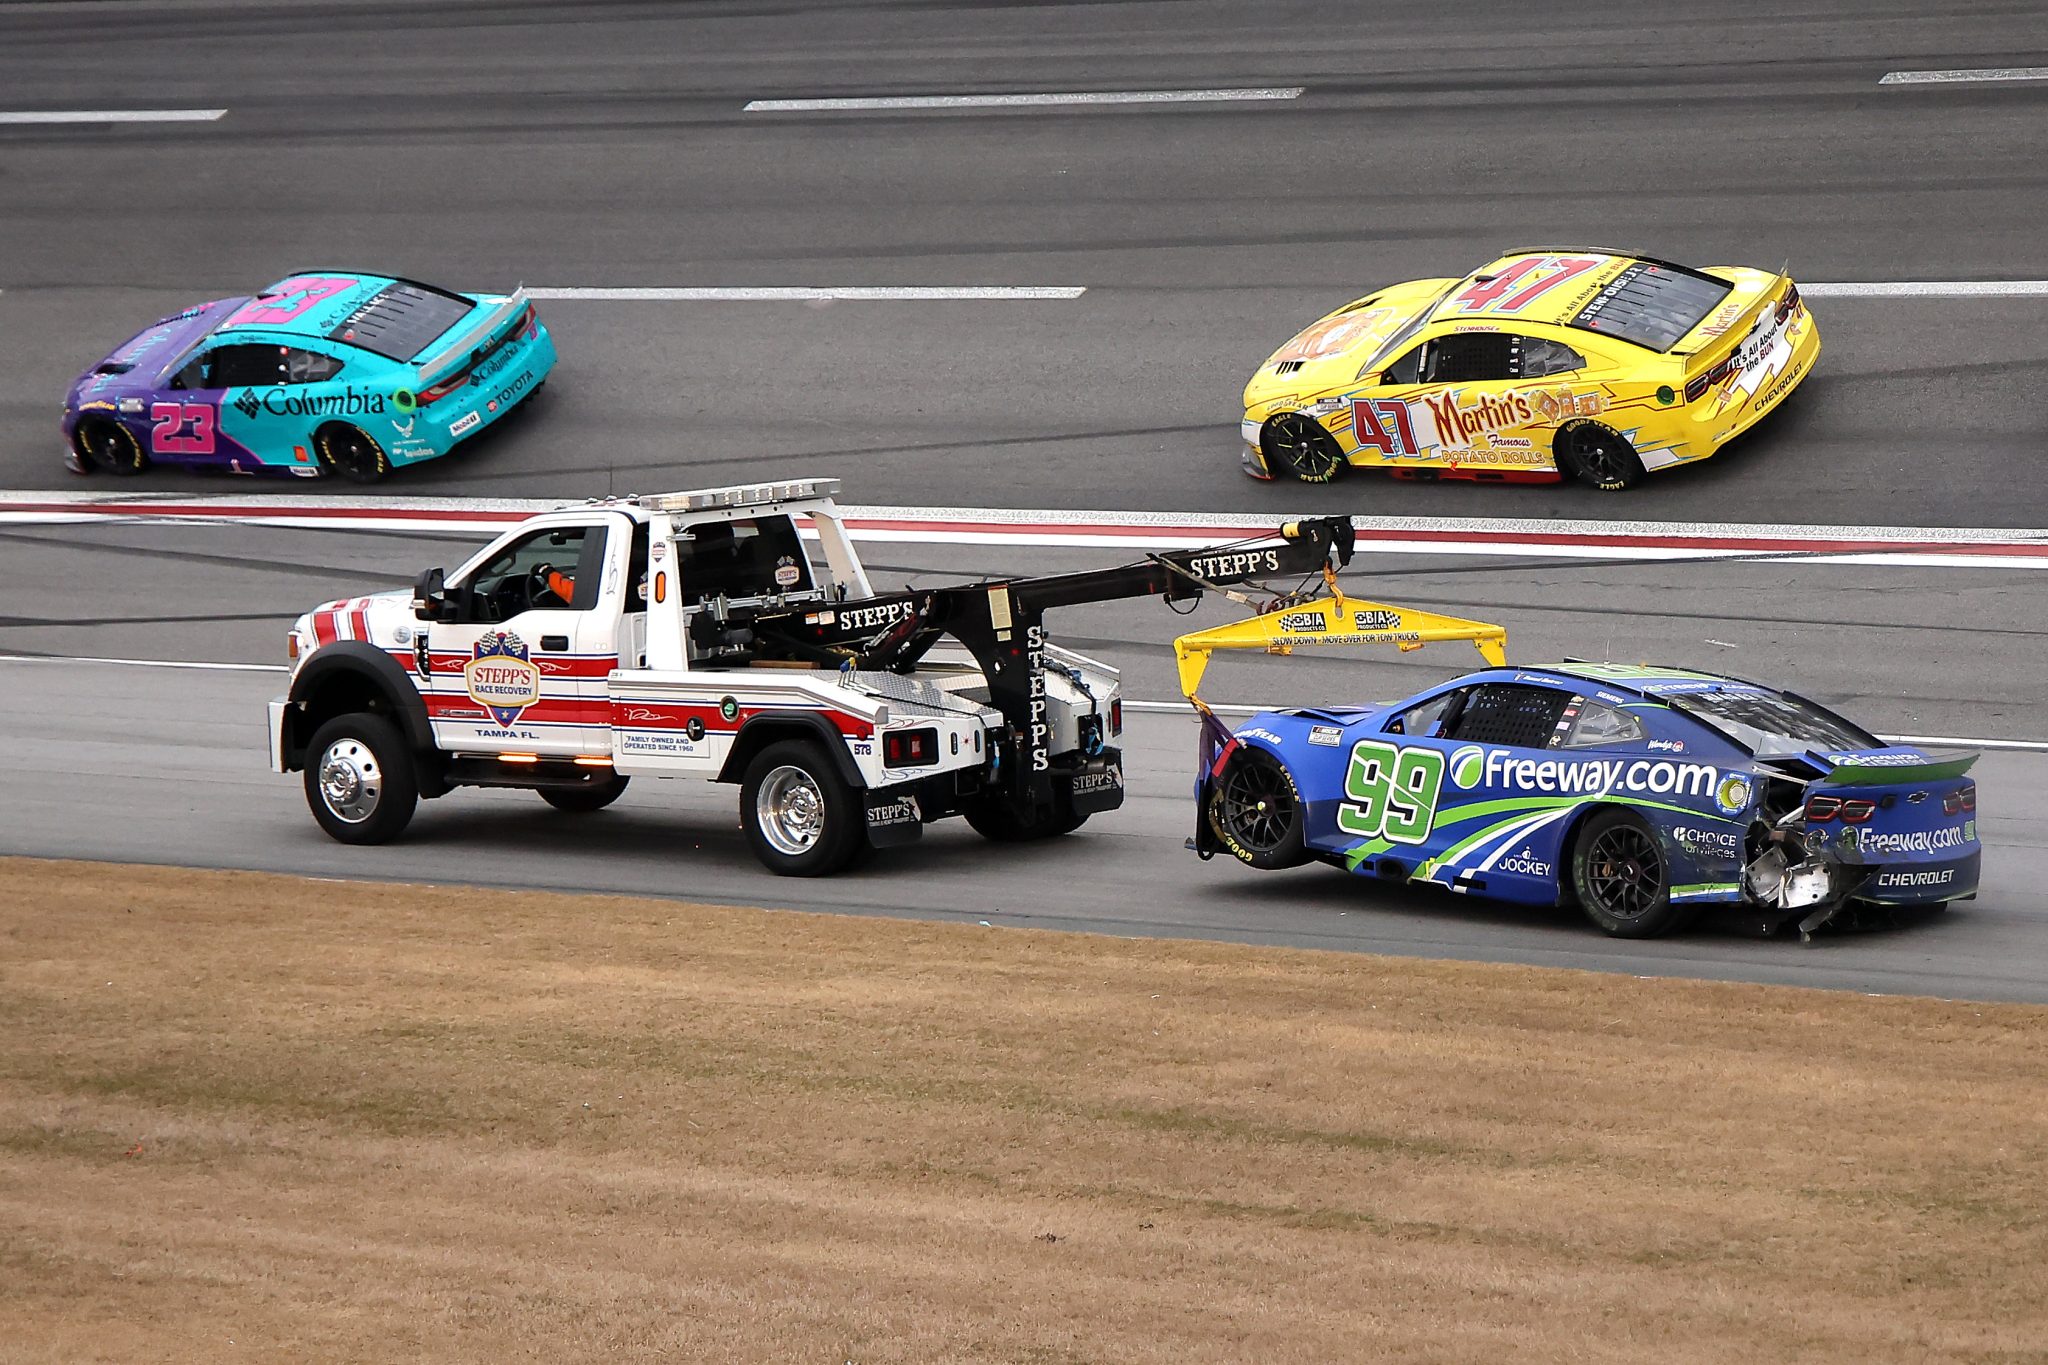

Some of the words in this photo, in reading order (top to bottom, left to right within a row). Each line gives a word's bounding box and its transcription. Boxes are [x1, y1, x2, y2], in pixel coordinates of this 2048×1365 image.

[1455, 257, 1600, 312] 47
[1576, 281, 1603, 300] Abou
[1748, 343, 1758, 357] All
[1759, 324, 1778, 348] About
[1746, 358, 1759, 372] the
[1759, 341, 1775, 360] BUN
[497, 370, 533, 406] TOYOTA
[1754, 361, 1803, 412] CHEVROLET
[263, 384, 385, 416] Columbia
[151, 402, 215, 454] 23
[1271, 413, 1292, 428] EAGLE
[1353, 399, 1419, 457] 47
[1424, 391, 1531, 447] Martin's
[1487, 434, 1531, 449] Famous
[1442, 450, 1498, 464] POTATO
[1503, 451, 1546, 464] ROLLS
[1189, 549, 1280, 579] STEPP'S
[840, 601, 914, 632] STEPP'S
[1273, 637, 1292, 646] SLOW
[1294, 635, 1316, 645] DOWN
[1322, 634, 1342, 644] MOVE
[1344, 634, 1361, 643] OVER
[1362, 633, 1375, 642] FOR
[1376, 633, 1393, 641] TOW
[1394, 632, 1420, 641] TRUCKS
[474, 668, 531, 685] STEPP'S
[475, 685, 494, 694] RACE
[494, 686, 532, 696] RECOVERY
[1596, 690, 1625, 704] SIEMENS
[475, 729, 516, 739] TAMPA
[854, 744, 873, 756] 578
[1647, 739, 1672, 750] Wendy's
[1072, 771, 1113, 790] STEPP'S
[1486, 749, 1719, 797] Freeway.com
[1336, 740, 1446, 846] 99
[867, 803, 910, 822] STEPP'S
[1686, 829, 1737, 847] CHOICE
[1859, 826, 1964, 855] Freeway.com
[1498, 856, 1550, 876] JOCKEY
[1877, 868, 1955, 887] CHEVROLET
